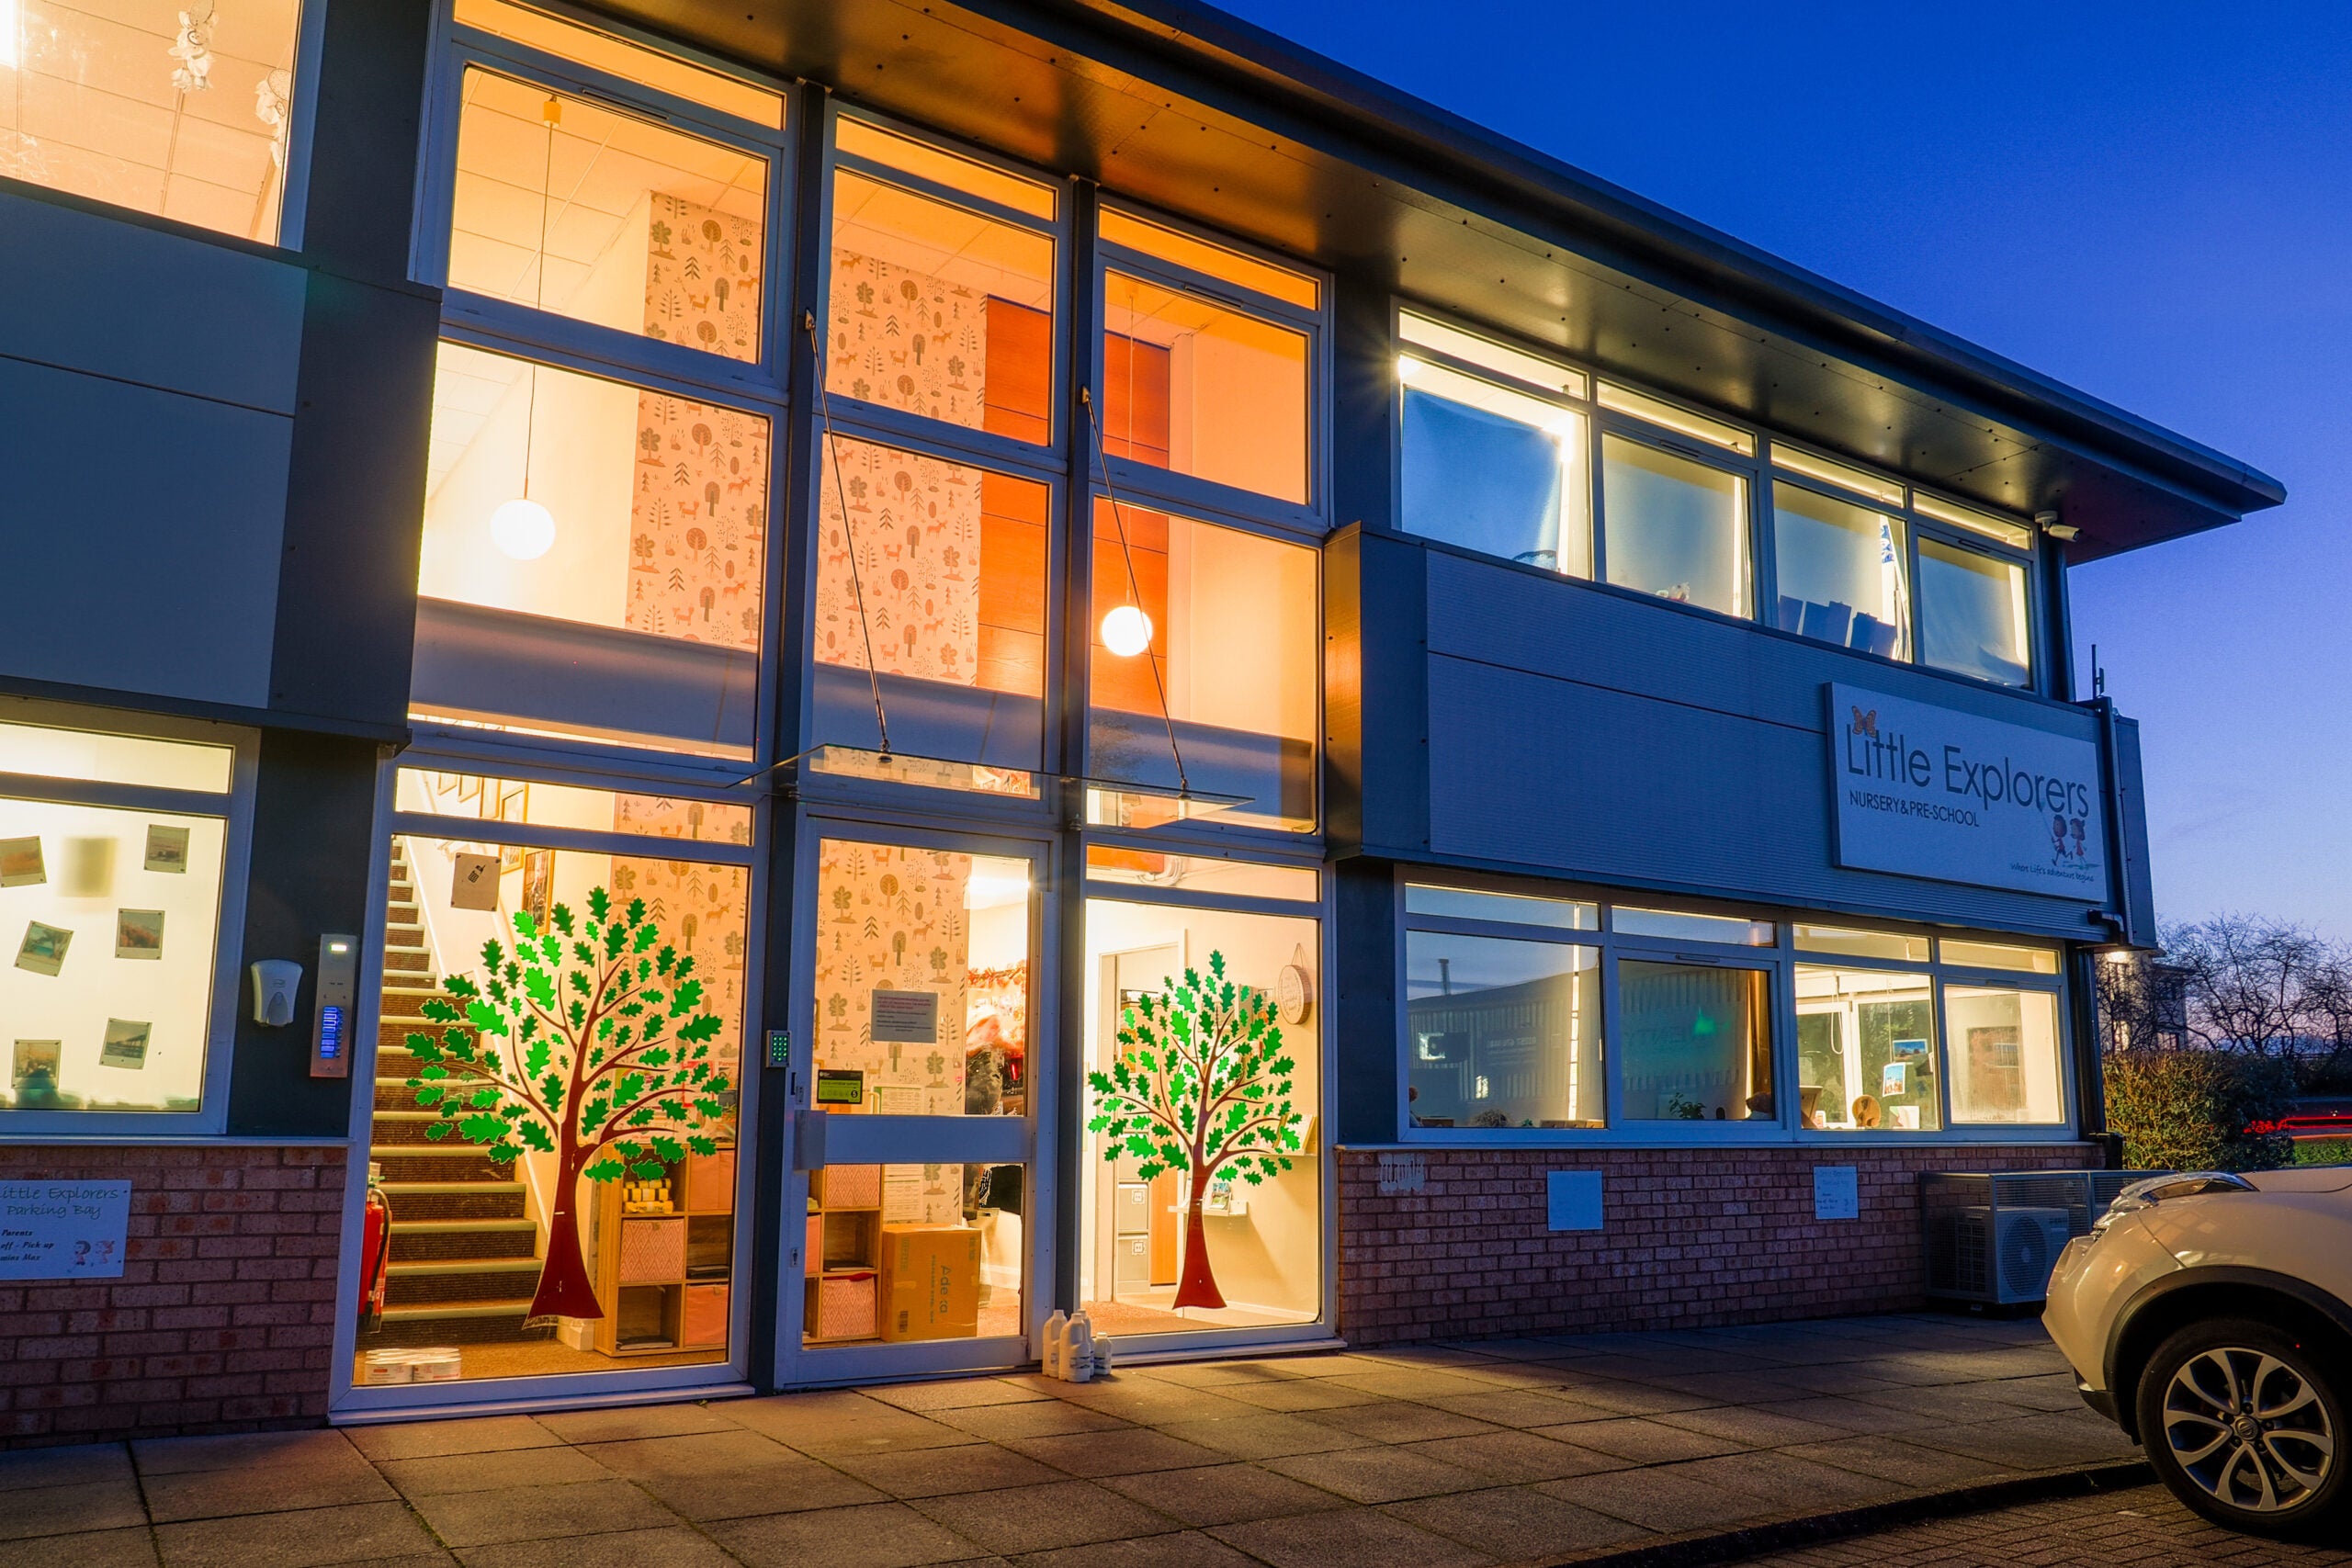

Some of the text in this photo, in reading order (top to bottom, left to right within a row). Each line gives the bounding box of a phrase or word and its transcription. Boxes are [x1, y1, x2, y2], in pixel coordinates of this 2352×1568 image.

[1847, 723, 2089, 818] Little Explorers
[0, 1186, 119, 1203] ittle Explorers
[74, 1204, 101, 1220] Bay
